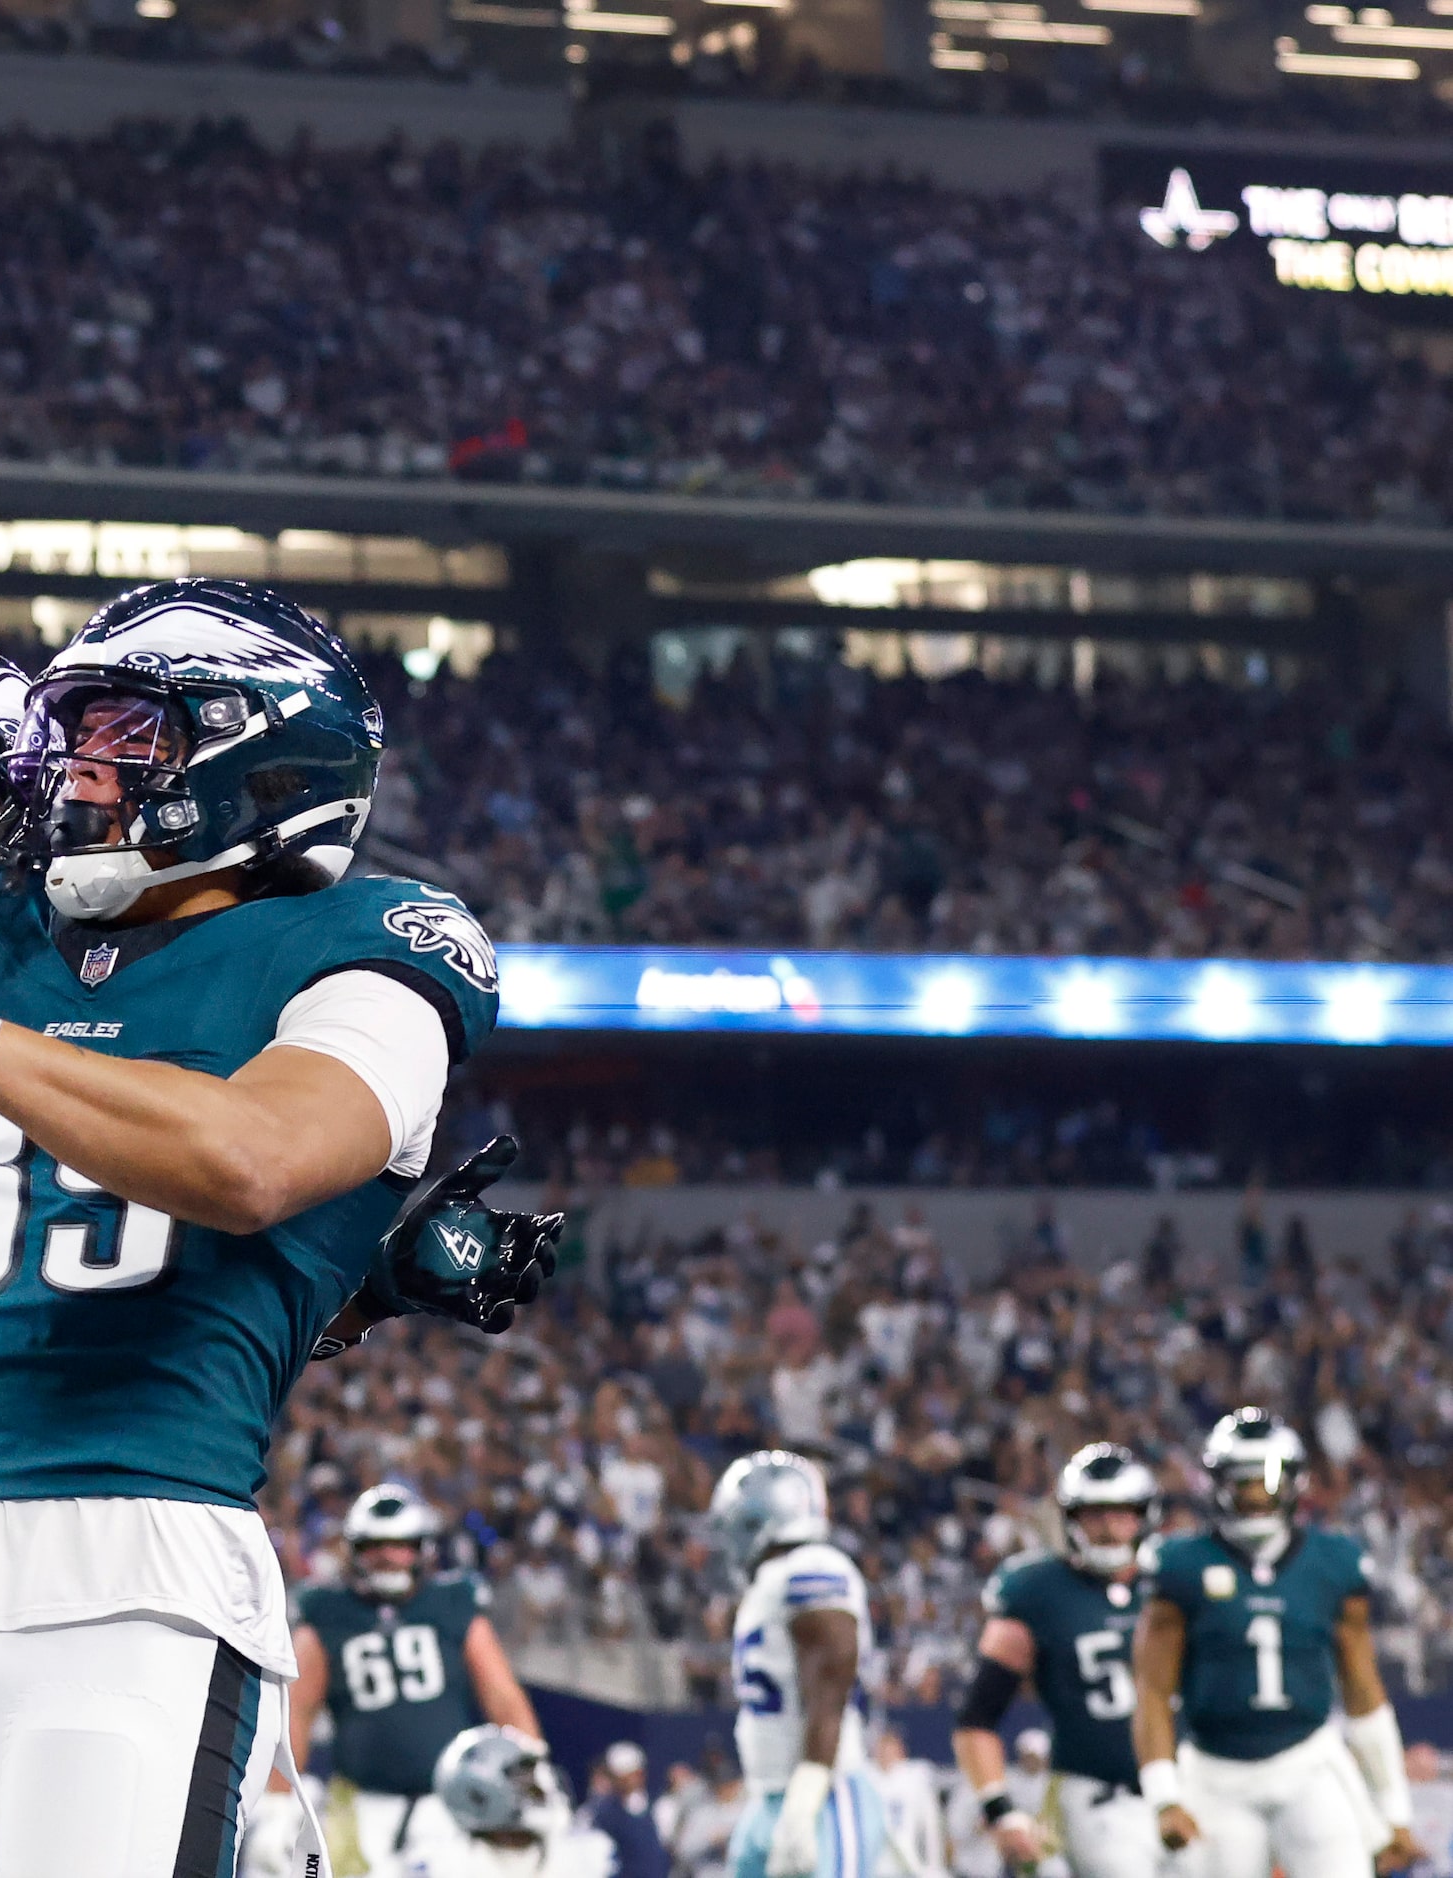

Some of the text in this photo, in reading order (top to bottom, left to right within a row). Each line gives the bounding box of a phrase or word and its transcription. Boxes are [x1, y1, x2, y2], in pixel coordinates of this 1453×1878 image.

[42, 1021, 124, 1039] EAGLES
[342, 1624, 446, 1712] 69
[1074, 1628, 1139, 1720] 5
[1244, 1614, 1294, 1712] 1
[304, 1852, 320, 1878] NXT
